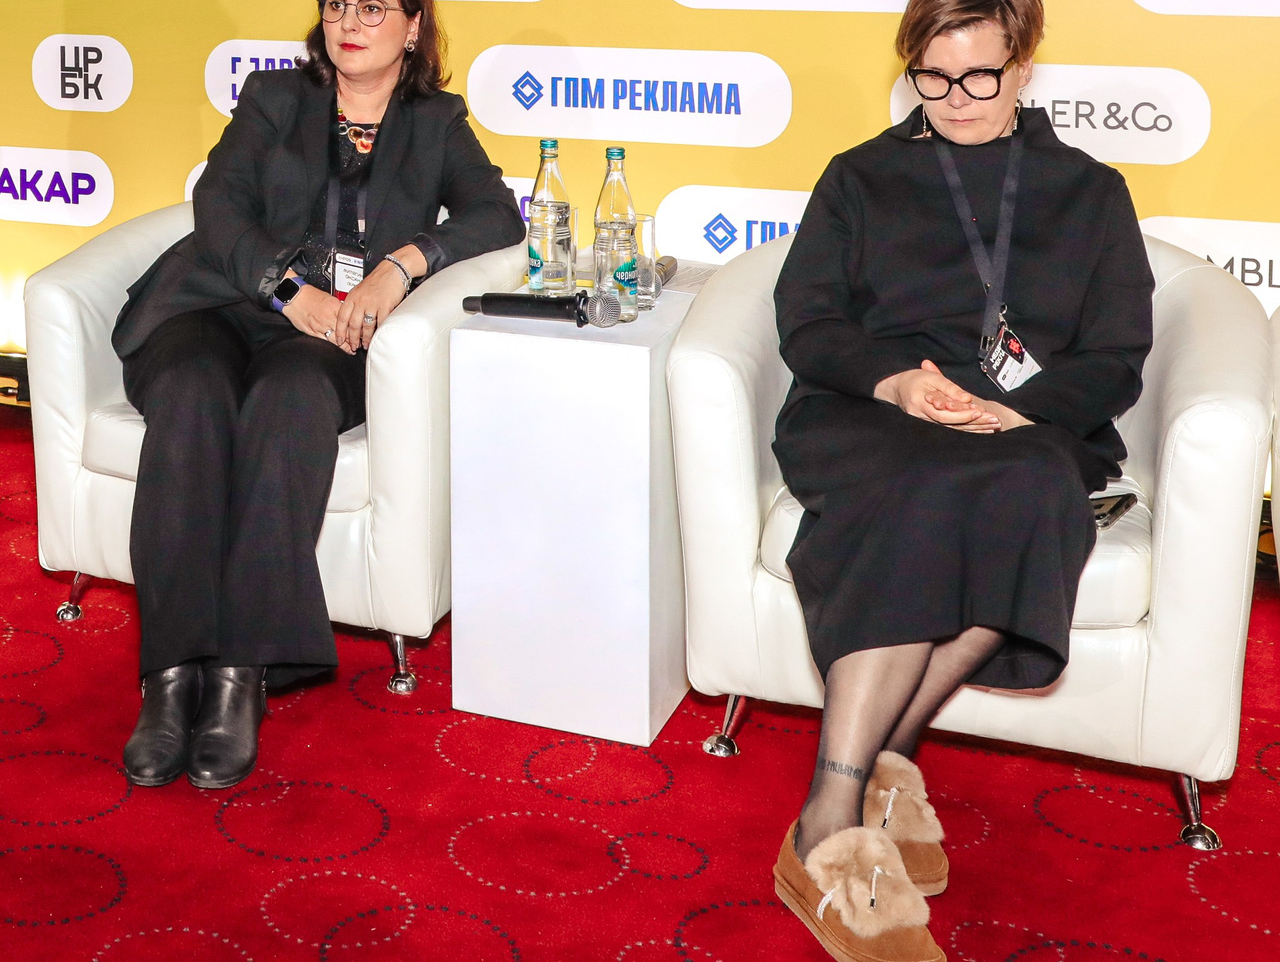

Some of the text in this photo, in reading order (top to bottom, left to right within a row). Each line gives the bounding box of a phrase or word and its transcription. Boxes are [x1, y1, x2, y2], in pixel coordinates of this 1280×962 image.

[60, 45, 104, 79] ЦР
[60, 72, 104, 101] БК
[550, 76, 742, 115] ГПМ РЕКЛАМА
